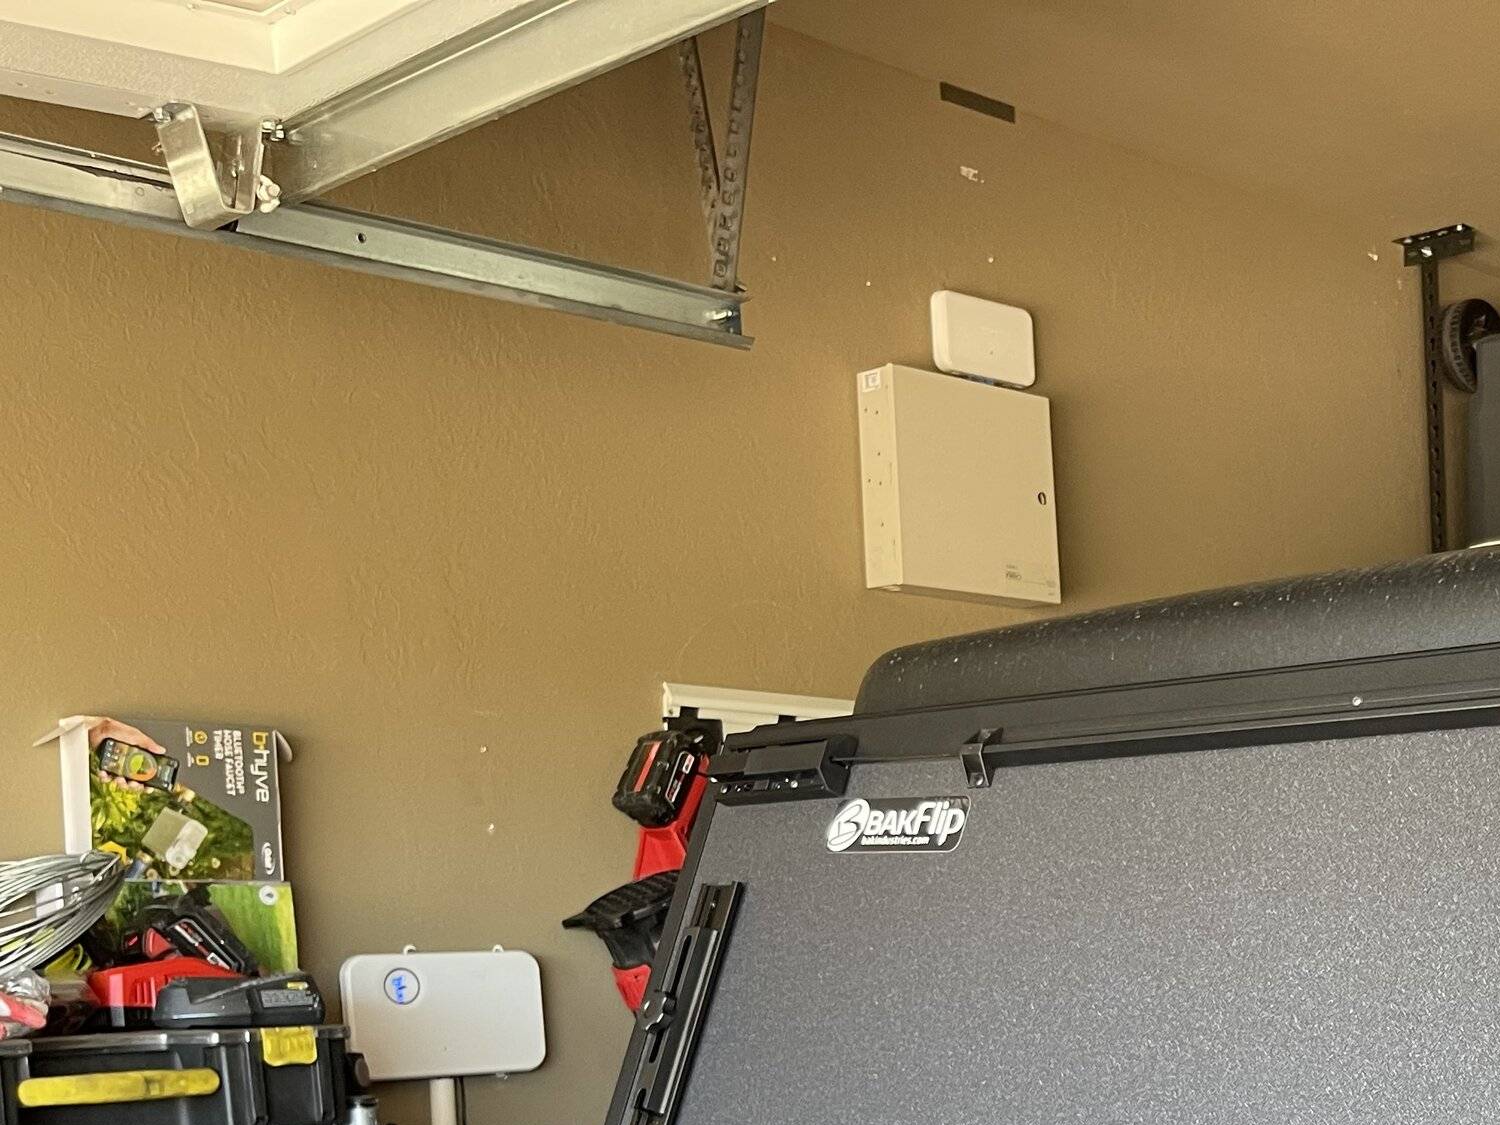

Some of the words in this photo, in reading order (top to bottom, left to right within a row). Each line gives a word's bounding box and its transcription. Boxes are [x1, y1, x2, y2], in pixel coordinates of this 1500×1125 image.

[213, 730, 224, 760] TIMER
[223, 729, 234, 757] HOSE
[225, 757, 236, 797] FAUCET
[864, 800, 966, 847] BAKFlip
